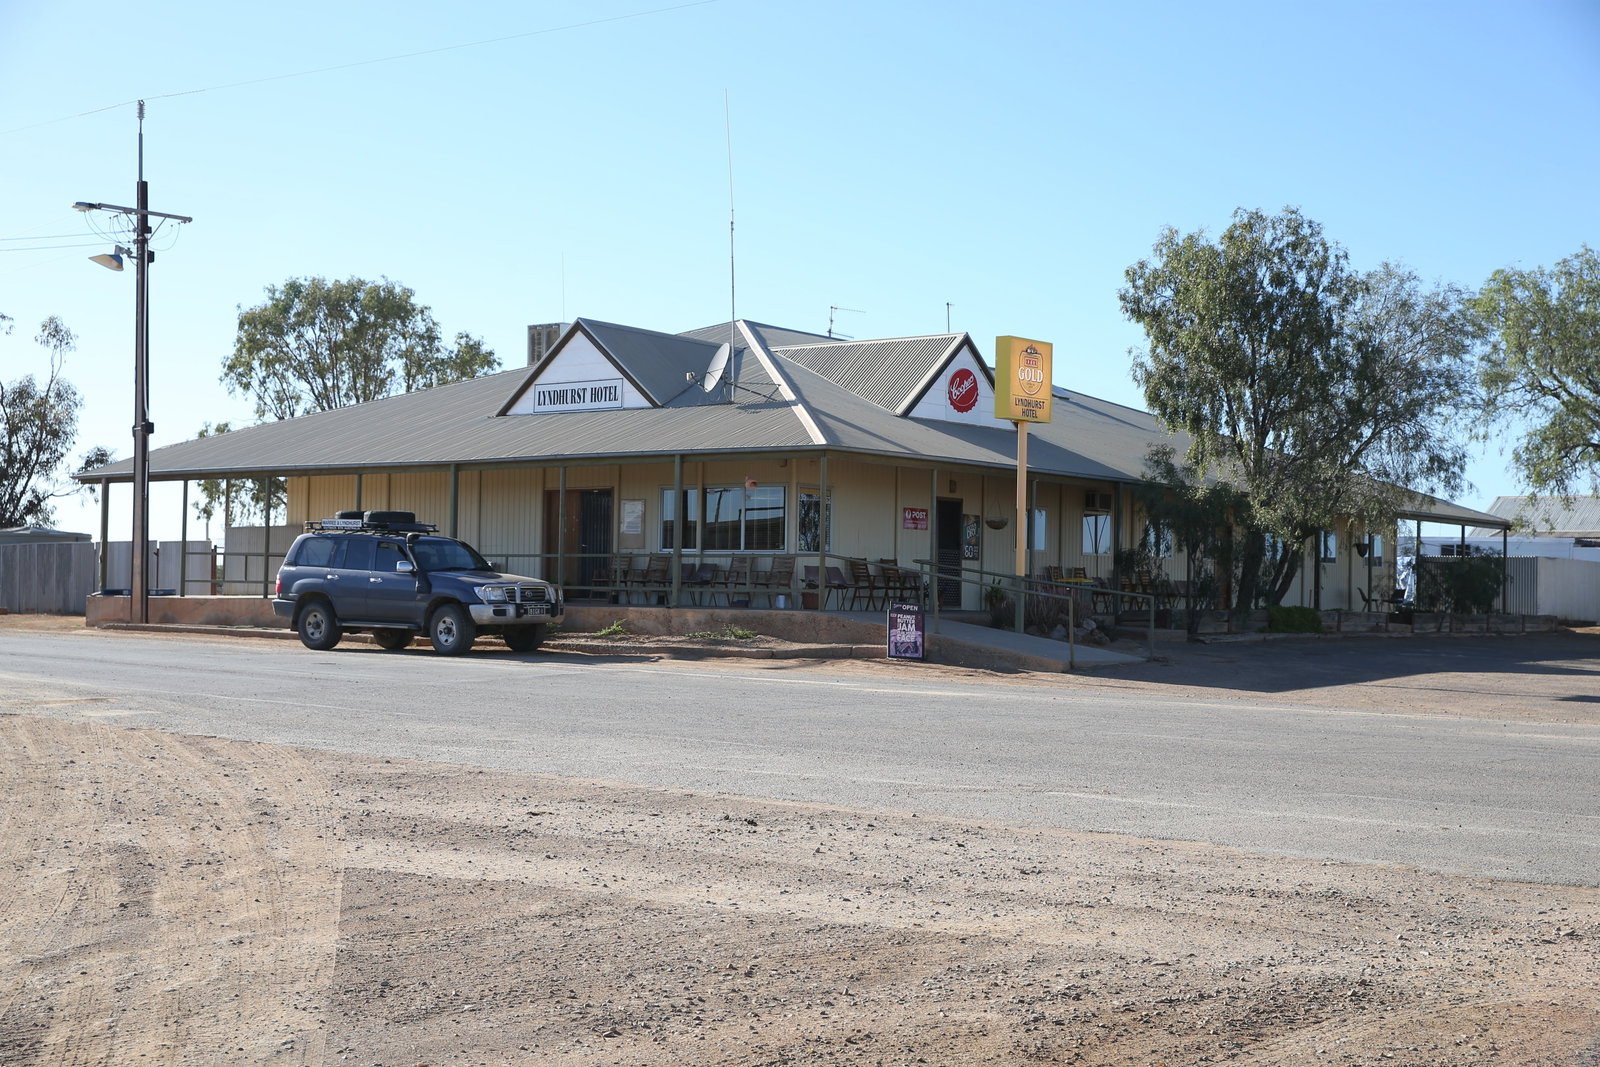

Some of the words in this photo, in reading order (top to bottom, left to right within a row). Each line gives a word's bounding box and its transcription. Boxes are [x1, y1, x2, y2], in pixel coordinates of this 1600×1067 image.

[1018, 366, 1043, 383] GOLD
[537, 387, 587, 406] LYNDHURST
[590, 384, 618, 403] HOTEL
[1014, 397, 1045, 410] LYNDHURST
[1021, 408, 1038, 419] HOTEL
[912, 511, 927, 519] POST
[897, 623, 916, 632] JAM
[896, 633, 916, 643] FACE
